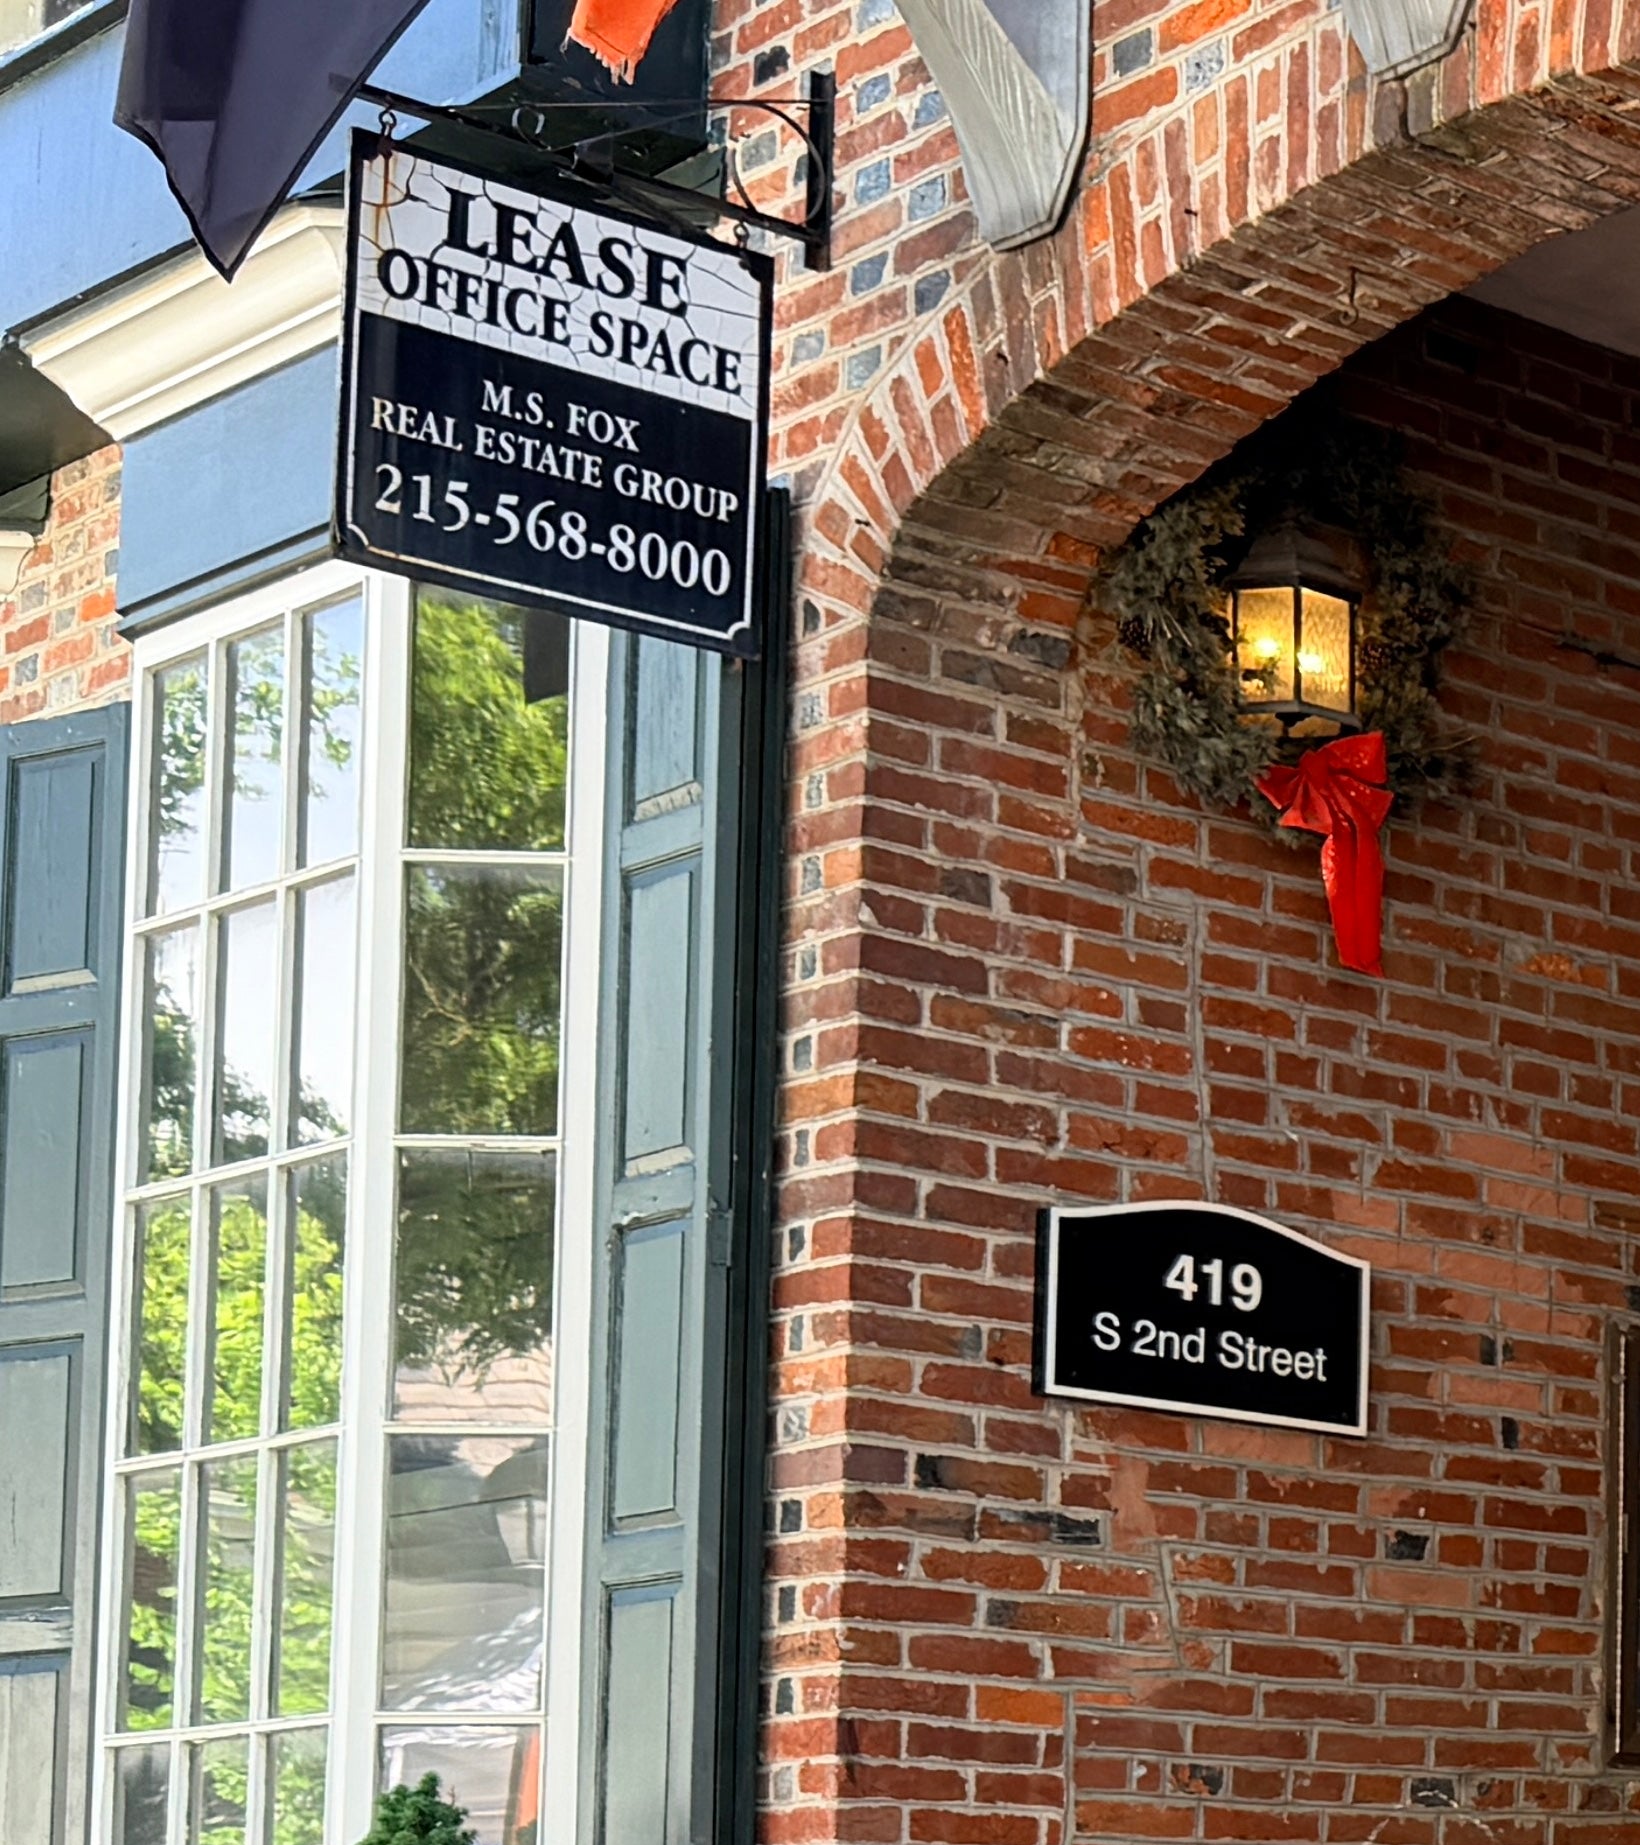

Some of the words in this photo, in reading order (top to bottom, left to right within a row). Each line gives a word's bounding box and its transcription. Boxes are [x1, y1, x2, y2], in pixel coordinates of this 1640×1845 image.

[447, 186, 690, 318] LEASE
[377, 247, 572, 347] OFFICE
[588, 310, 742, 396] SPACE
[370, 396, 463, 452] REAL
[474, 424, 603, 488] ESTATE
[613, 463, 739, 524] GROUP
[480, 379, 555, 429] M.S.
[566, 402, 640, 453] FOX
[374, 462, 731, 598] 215-568-8000
[1091, 1311, 1122, 1352] S
[1131, 1318, 1206, 1365] 2nd
[1217, 1330, 1328, 1383] Street
[1163, 1253, 1264, 1313] 419
